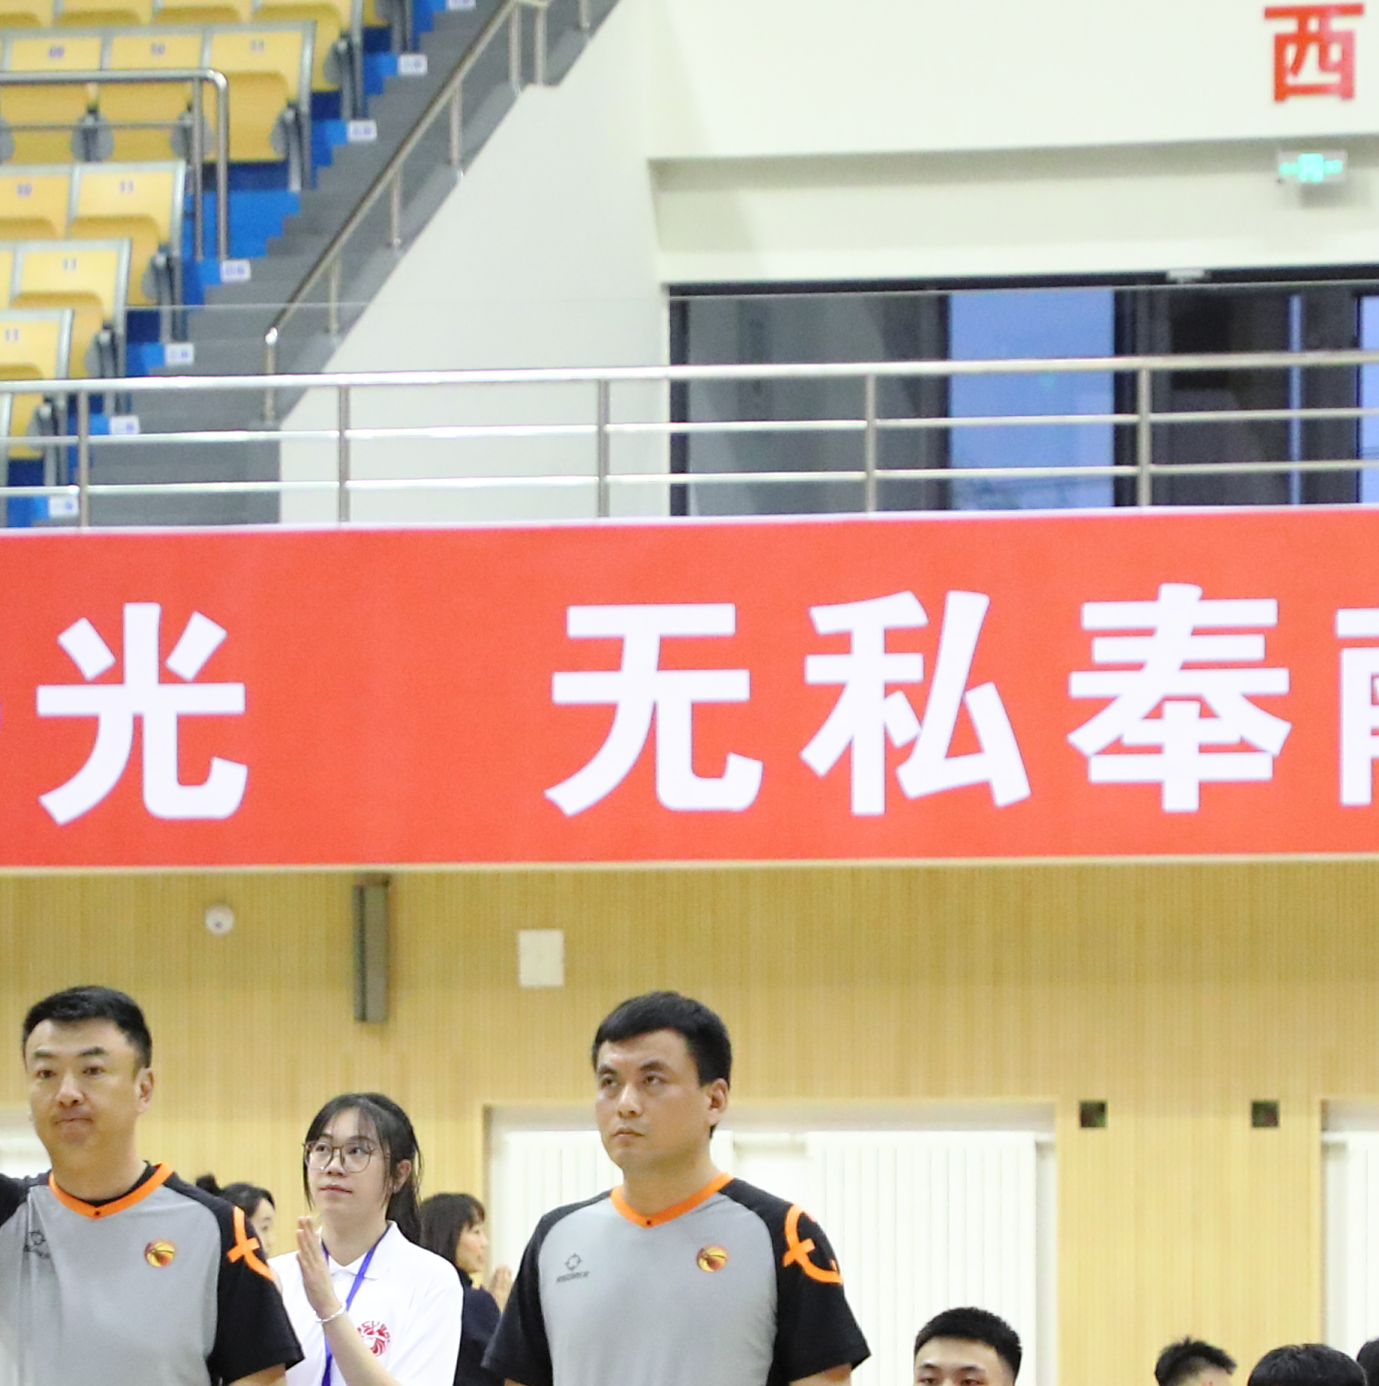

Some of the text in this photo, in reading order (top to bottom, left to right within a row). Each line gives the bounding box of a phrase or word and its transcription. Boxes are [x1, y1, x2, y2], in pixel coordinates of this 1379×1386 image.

[1264, 3, 1364, 103] 西
[544, 583, 1379, 816] 无私奉
